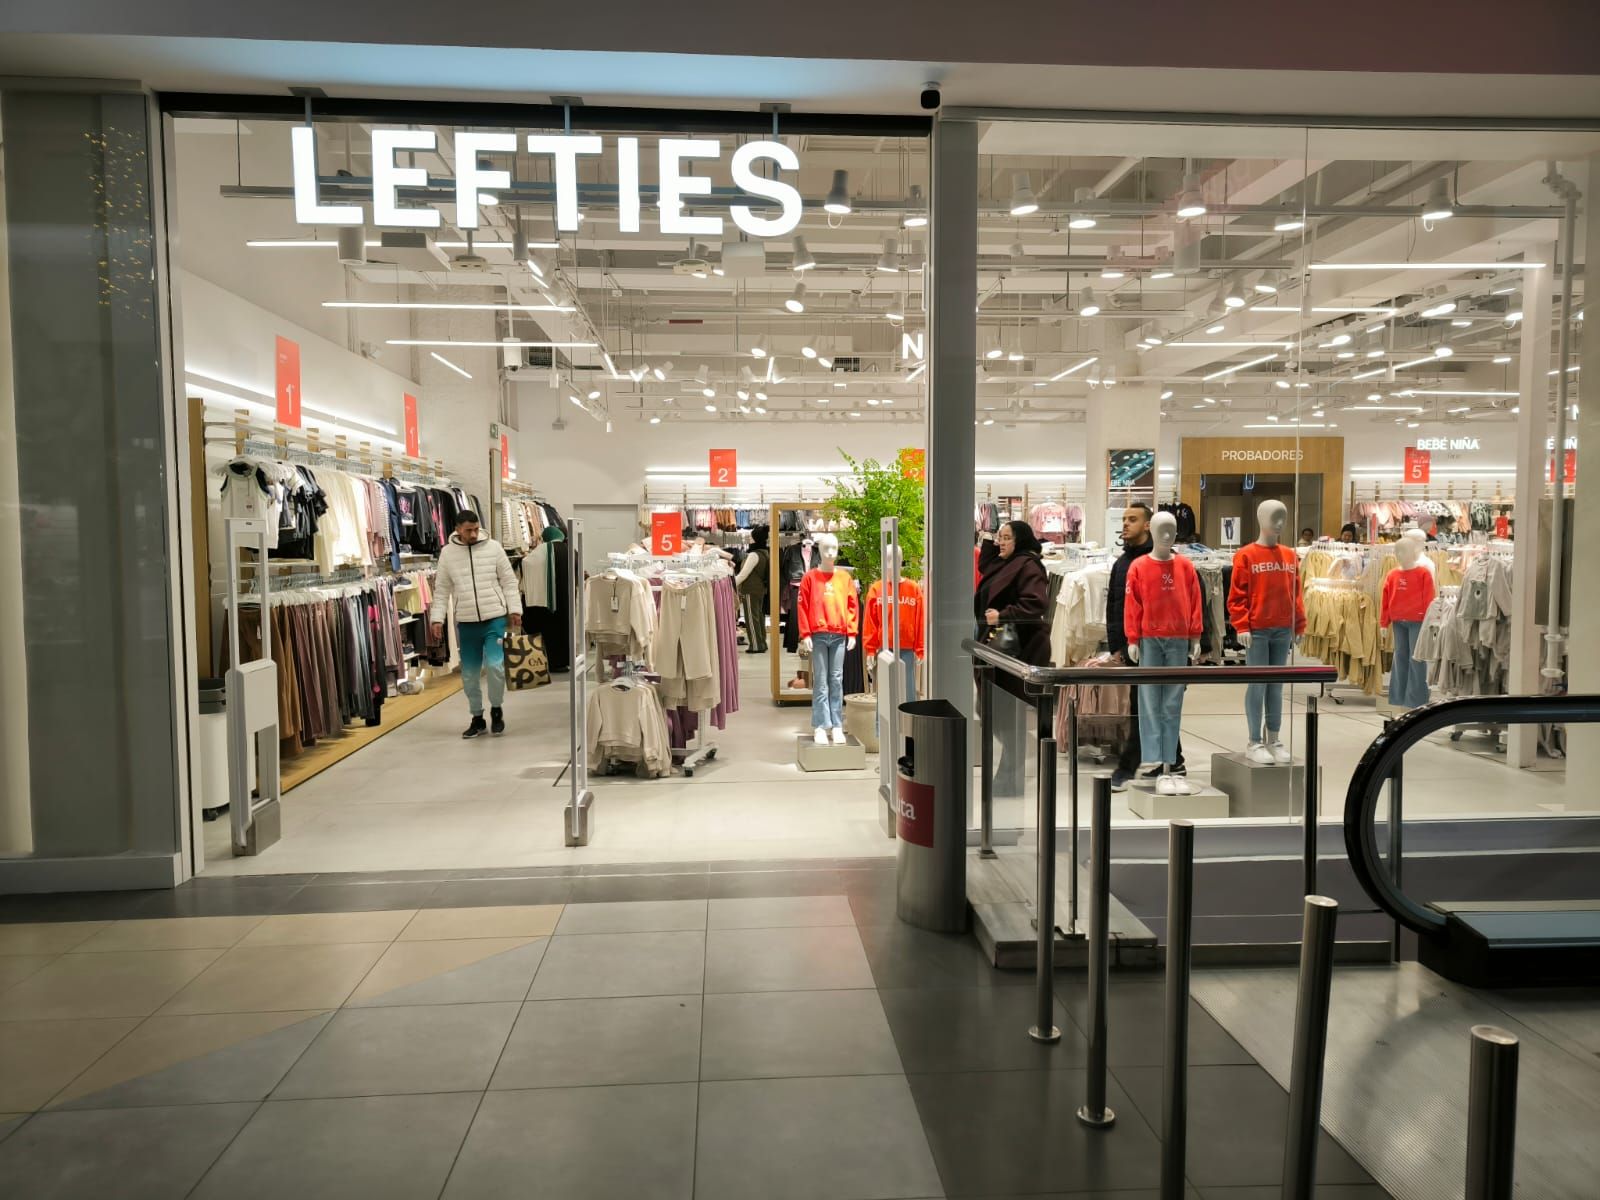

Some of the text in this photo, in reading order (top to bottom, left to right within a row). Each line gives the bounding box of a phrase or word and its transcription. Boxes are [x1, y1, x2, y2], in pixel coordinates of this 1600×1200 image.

[291, 126, 803, 237] LEFTIES
[1417, 436, 1480, 450] BEBÉ NIÑA
[1221, 449, 1304, 461] PROBADORES
[718, 467, 729, 483] 2
[1412, 464, 1423, 479] 5
[660, 533, 673, 552] 5
[1251, 561, 1297, 575] REBAJAS
